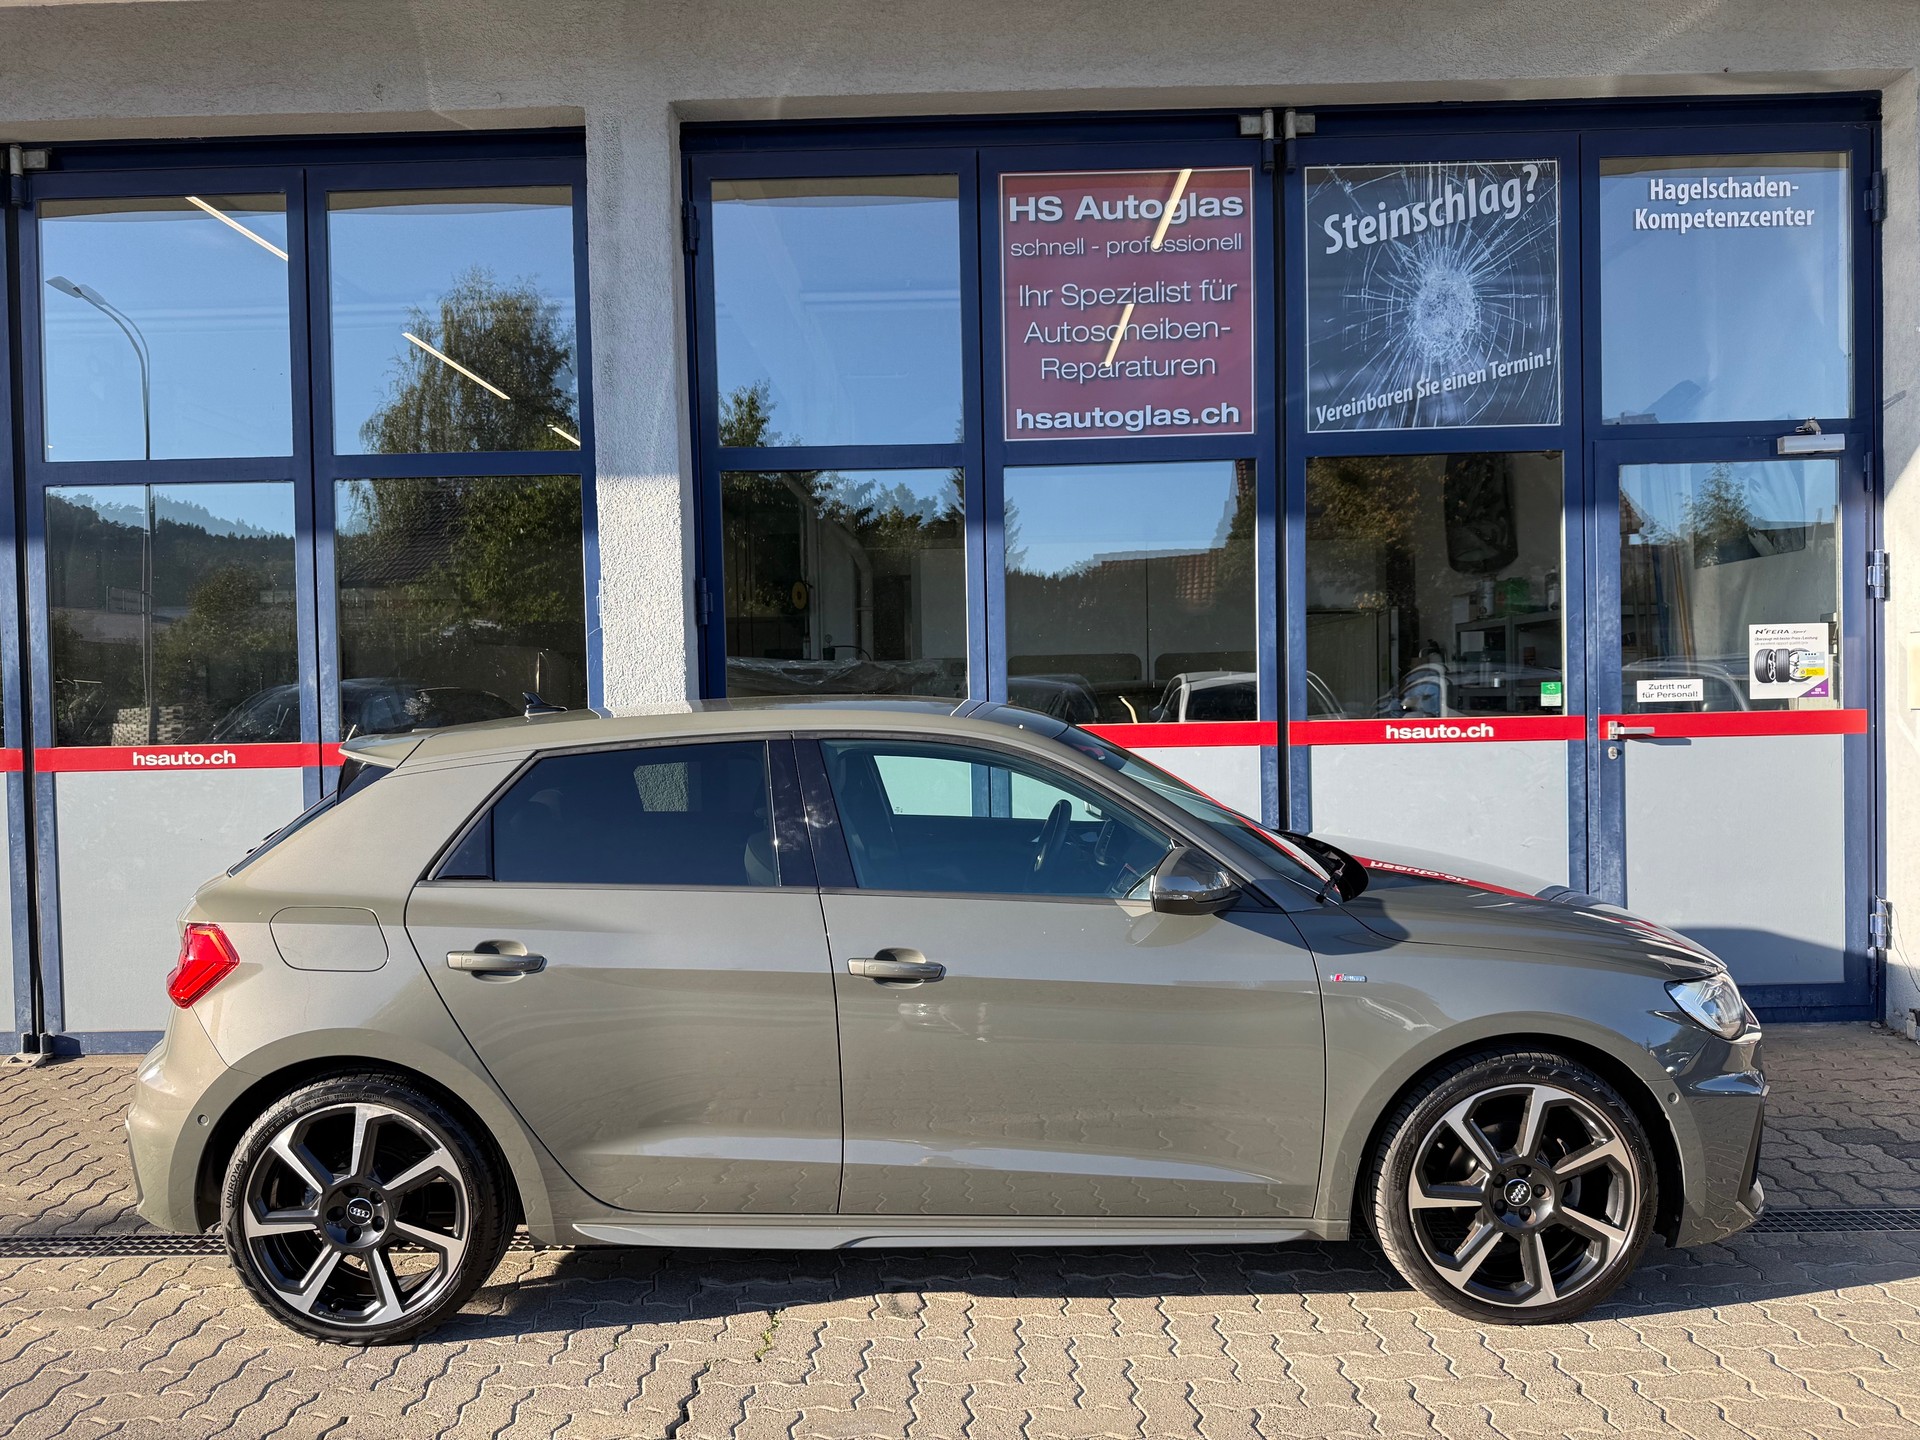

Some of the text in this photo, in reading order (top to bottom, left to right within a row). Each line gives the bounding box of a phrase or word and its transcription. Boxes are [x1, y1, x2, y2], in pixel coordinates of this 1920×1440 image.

[1650, 176, 1799, 205] Hagelschaden-
[1009, 192, 1244, 225] HS Autoglas
[1324, 164, 1539, 255] Steinschlag?
[1635, 206, 1815, 234] Kompetenzcenter
[1010, 237, 1085, 257] schnell
[1106, 233, 1243, 259] professionell
[1019, 278, 1238, 311] Ihr Spezialist für
[1024, 317, 1231, 344] Autoscheiben-
[1041, 356, 1216, 385] Reparaturen
[1315, 386, 1414, 424] Vereinbaren
[1416, 378, 1440, 399] Sie
[1442, 368, 1487, 391] einen
[1016, 402, 1240, 432] hsautoglas.ch
[1642, 690, 1699, 699] für Personal!
[1385, 722, 1494, 739] hsauto.ch
[132, 750, 237, 766] hsauto.ch
[225, 1158, 244, 1209] UNIROYAL
